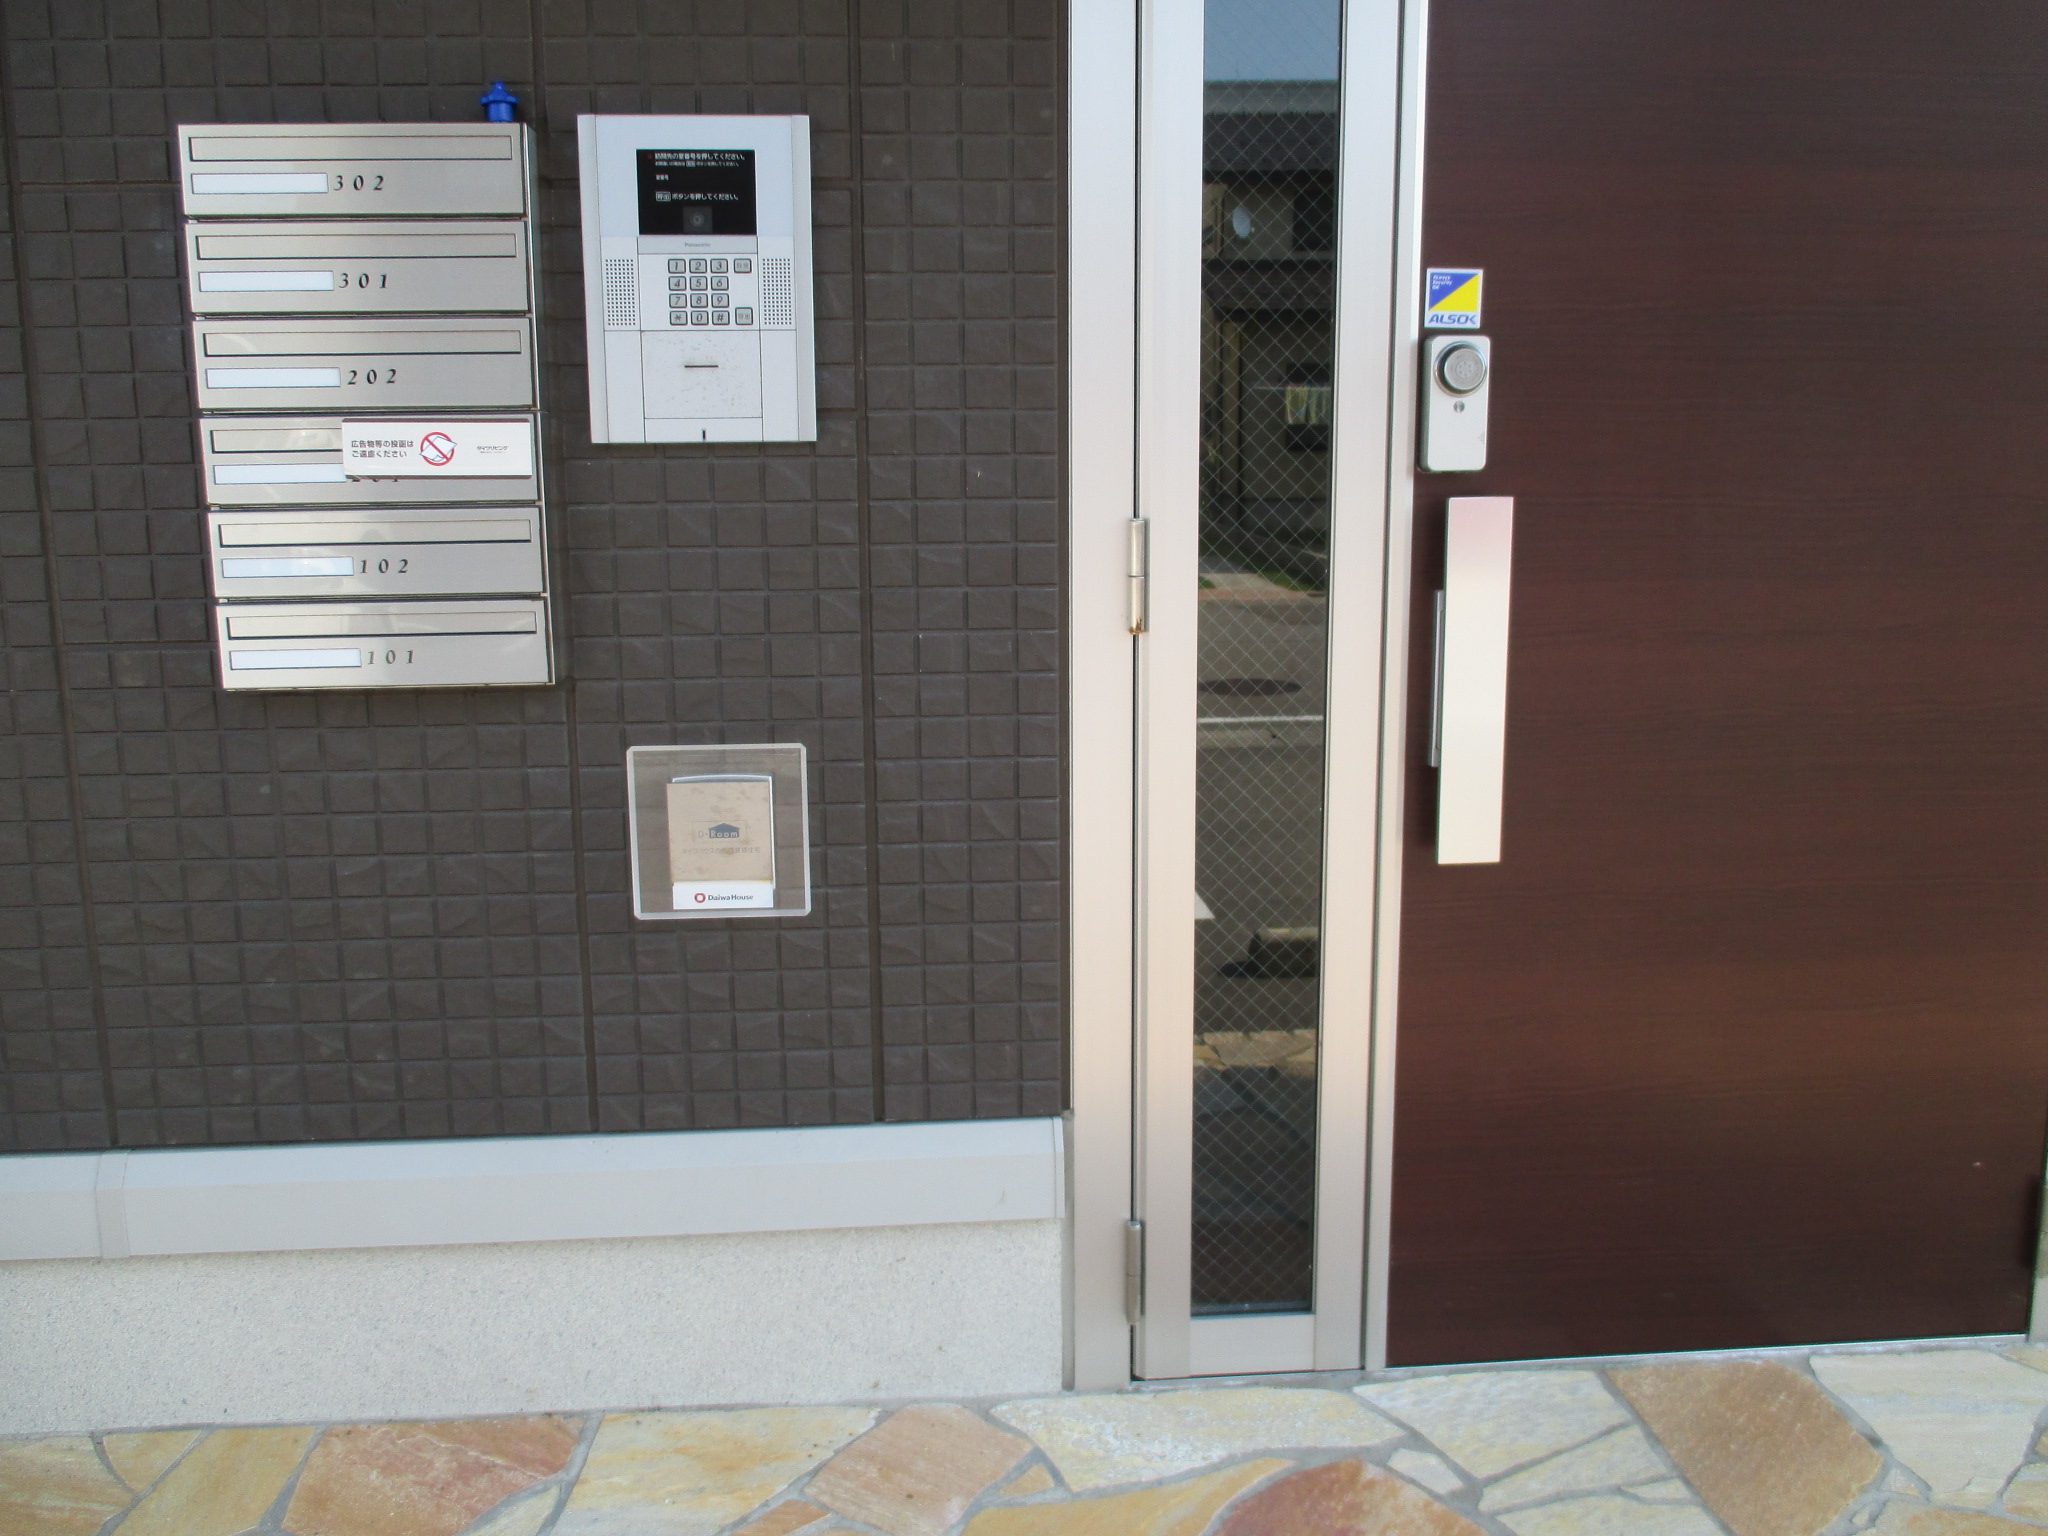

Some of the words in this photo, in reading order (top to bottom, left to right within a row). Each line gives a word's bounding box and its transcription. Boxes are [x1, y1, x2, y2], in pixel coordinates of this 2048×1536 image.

[333, 175, 384, 191] 302
[338, 273, 388, 289] 301
[1428, 314, 1477, 324] ALSOK
[347, 369, 397, 385] 202
[351, 440, 414, 448] 広告物等の投函は
[352, 450, 407, 458] ご遠慮ください
[359, 559, 409, 574] 102
[367, 650, 415, 665] 101
